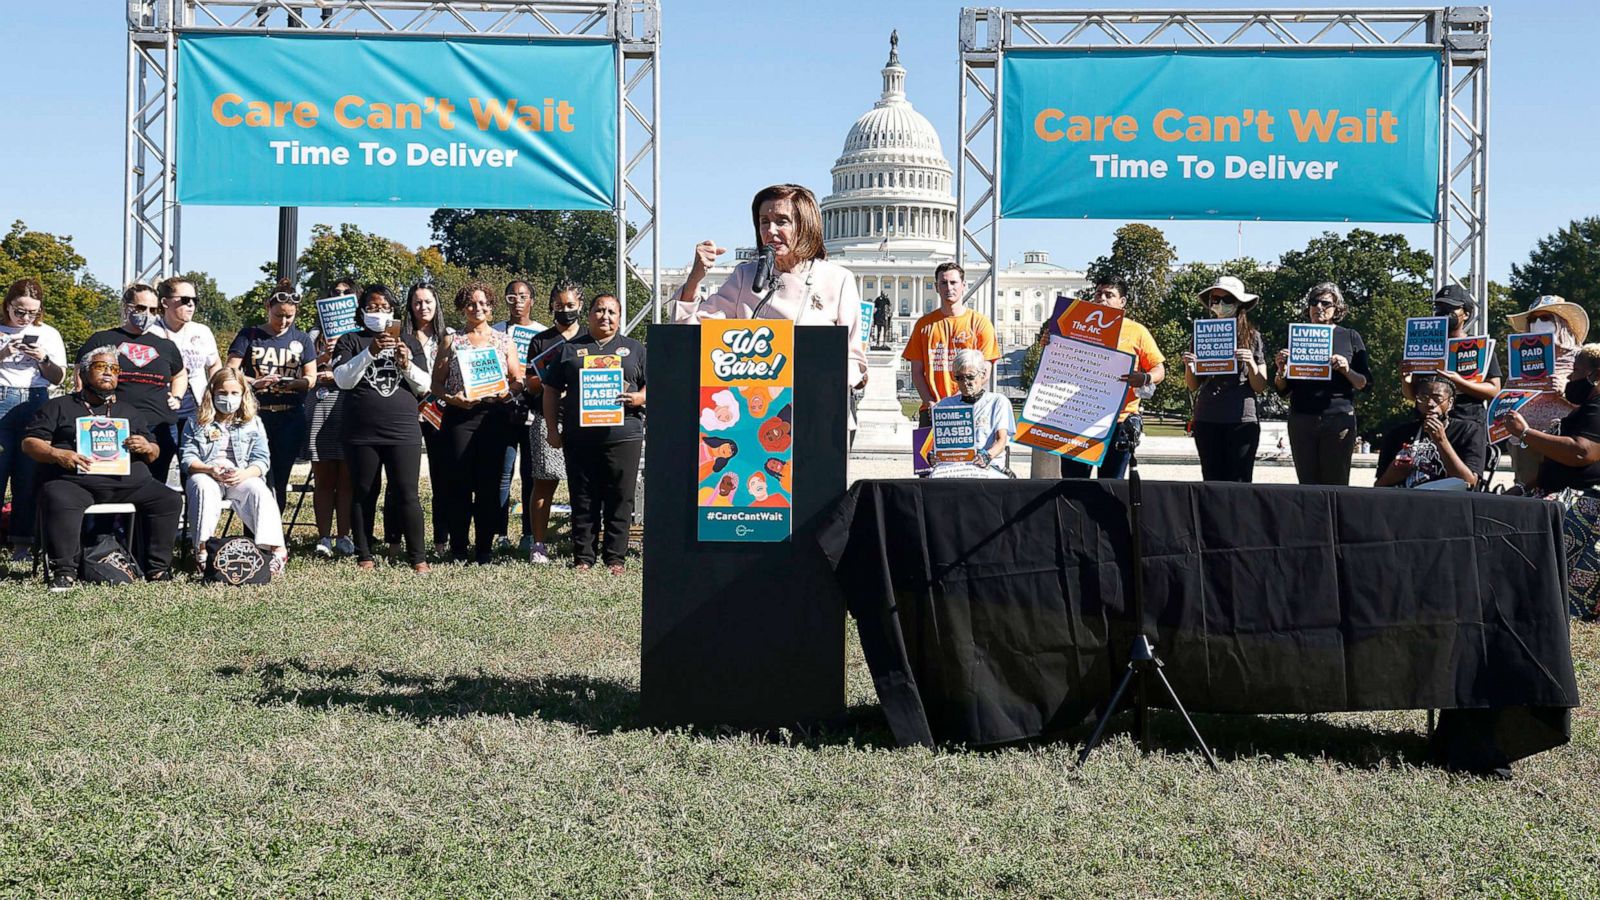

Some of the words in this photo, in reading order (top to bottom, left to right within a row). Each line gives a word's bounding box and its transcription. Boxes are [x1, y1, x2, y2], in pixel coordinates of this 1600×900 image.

[211, 93, 318, 128] Care
[333, 95, 456, 131] Can't
[468, 97, 575, 132] Wait
[1034, 108, 1138, 143] Care
[1152, 108, 1274, 143] Can't
[1290, 108, 1398, 143] Wait
[269, 140, 349, 166] Time
[359, 141, 397, 166] To
[407, 143, 518, 168] Deliver
[1090, 154, 1167, 179] Time
[1177, 155, 1214, 179] To
[1224, 154, 1338, 180] Deliver
[320, 299, 355, 313] LIVING
[324, 320, 339, 329] FOR
[1072, 321, 1087, 331] The
[1087, 325, 1102, 335] Arc
[1197, 323, 1232, 333] LIVING
[1413, 321, 1440, 330] TEXT
[1292, 328, 1329, 338] LIVING
[722, 327, 773, 356] We
[1213, 342, 1233, 350] CARE
[1408, 344, 1420, 352] TO
[1421, 344, 1444, 352] CALL
[1521, 347, 1543, 357] PAID
[1074, 347, 1097, 358] parents
[1097, 353, 1110, 361] that
[1457, 350, 1478, 359] PAID
[468, 359, 497, 367] ECARE
[711, 348, 786, 381] Care!
[1065, 353, 1086, 364] further
[1087, 359, 1101, 367] their
[1048, 359, 1070, 368] careers
[1080, 366, 1092, 374] fear
[1457, 363, 1478, 372] LEAVE
[1522, 363, 1545, 371] LEAVE
[583, 374, 612, 382] HOME-
[1046, 367, 1074, 377] eligibility
[1084, 376, 1107, 386] support
[1043, 373, 1067, 384] services
[1079, 383, 1098, 392] others
[584, 389, 621, 399] BASED
[1037, 389, 1062, 399] lucrative
[1063, 397, 1085, 405] careers
[1055, 384, 1066, 392] had
[1074, 391, 1099, 400] abandon
[1032, 404, 1053, 414] qualify
[1044, 399, 1068, 409] children
[935, 412, 963, 420] HOME-
[91, 430, 117, 438] PAID
[936, 426, 973, 437] BASED
[937, 436, 974, 445] SERVICES
[1030, 427, 1089, 449] #CareCantWait
[707, 511, 783, 521] #CareCantWait
